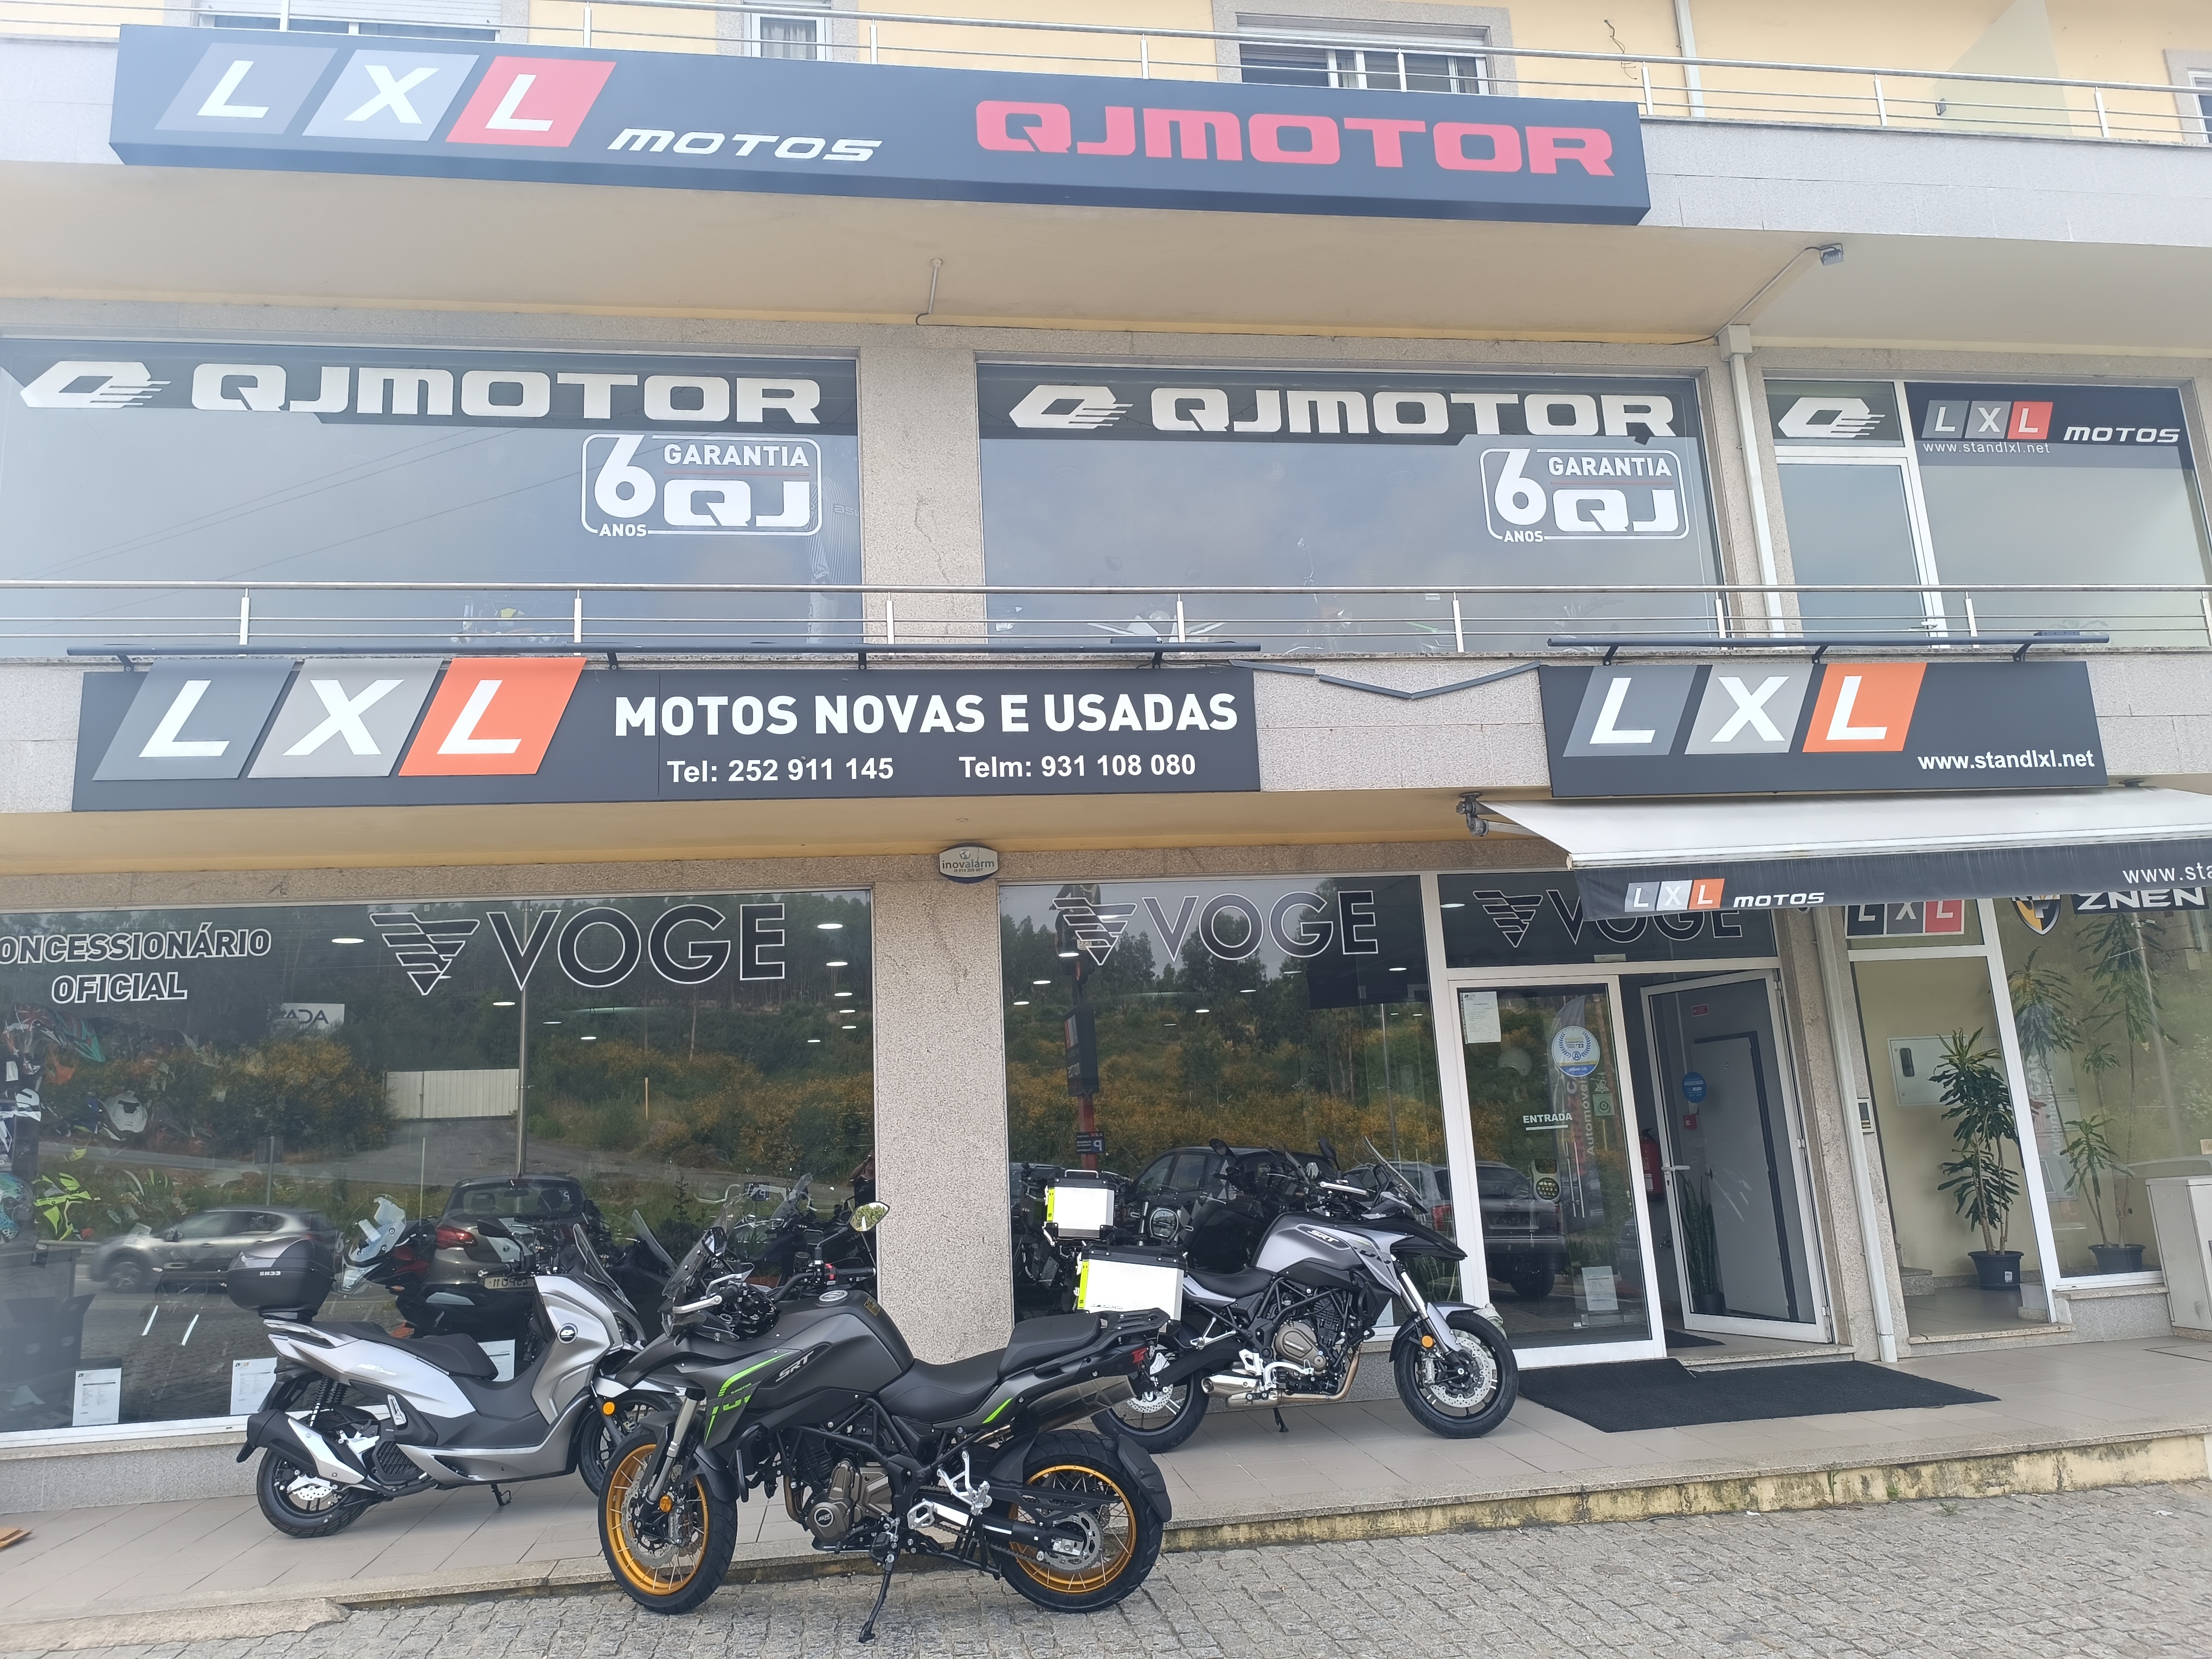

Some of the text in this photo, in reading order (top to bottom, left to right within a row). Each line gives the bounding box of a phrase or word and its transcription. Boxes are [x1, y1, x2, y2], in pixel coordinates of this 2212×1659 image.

[197, 60, 882, 162] LXL MOTOS
[975, 100, 1614, 177] QJMOTOR
[191, 363, 820, 424] QJMOTOR
[1151, 388, 1676, 437] QJMOTOR
[1934, 406, 2181, 443] LXL MOTOS
[664, 444, 810, 467] GARANTIA
[1923, 441, 2051, 454] www.standlxl.net
[594, 434, 657, 519] 6
[1548, 456, 1673, 477] GARANTIA
[664, 479, 810, 527] QJ
[1494, 448, 1547, 526] 6
[1552, 489, 1679, 532] QJ
[599, 523, 647, 537] ANOS
[1504, 530, 1544, 543] ANOS
[139, 679, 522, 758] LXL
[614, 692, 1238, 737] MOTOS NOVAS E USADAS
[1589, 676, 1888, 744] LXL
[667, 757, 894, 783] Tel: 252 911 145
[959, 753, 1196, 779] Telm: 931 108 080
[1918, 749, 2095, 770] www.standlxl.net
[942, 859, 994, 869] inovalarm
[1634, 884, 1825, 908] LXL MOTOS
[2077, 888, 2205, 910] ZNEN
[1141, 890, 1379, 963] VOGE
[486, 903, 785, 992] VOGE
[52, 972, 188, 1004] OFICIAL
[1522, 1113, 1573, 1124] ENTRADA
[1307, 1230, 1340, 1242] SRT
[775, 1350, 814, 1382] SRT
